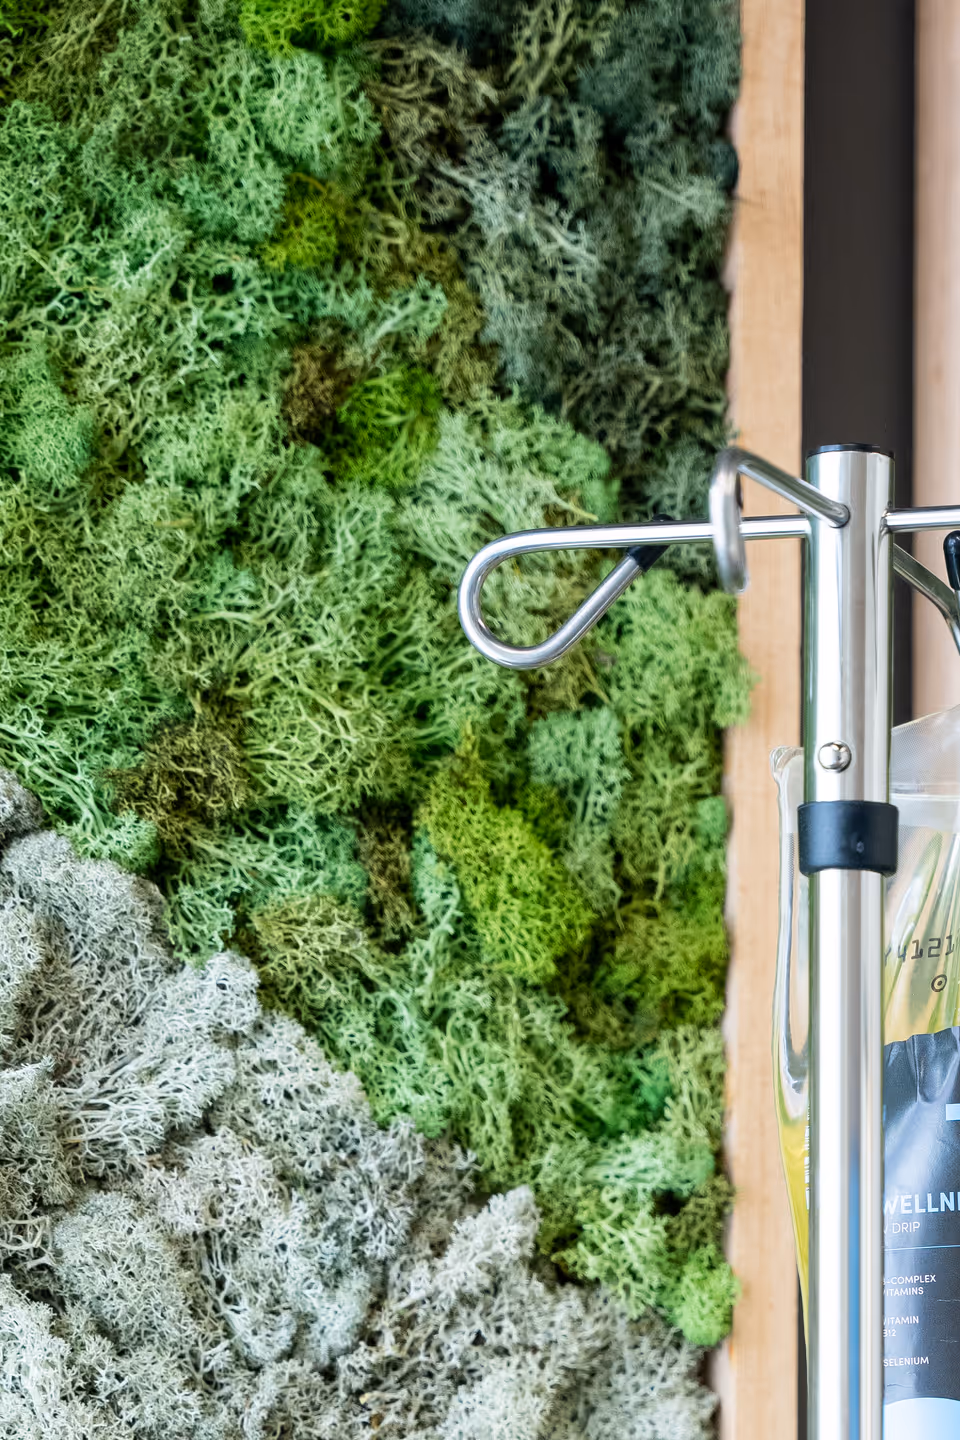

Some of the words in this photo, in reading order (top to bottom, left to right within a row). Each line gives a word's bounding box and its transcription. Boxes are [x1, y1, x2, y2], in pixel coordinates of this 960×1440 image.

[892, 1221, 921, 1234] DRIP
[883, 1274, 937, 1286] -COMPLEX
[883, 1356, 930, 1368] SELENIUM
